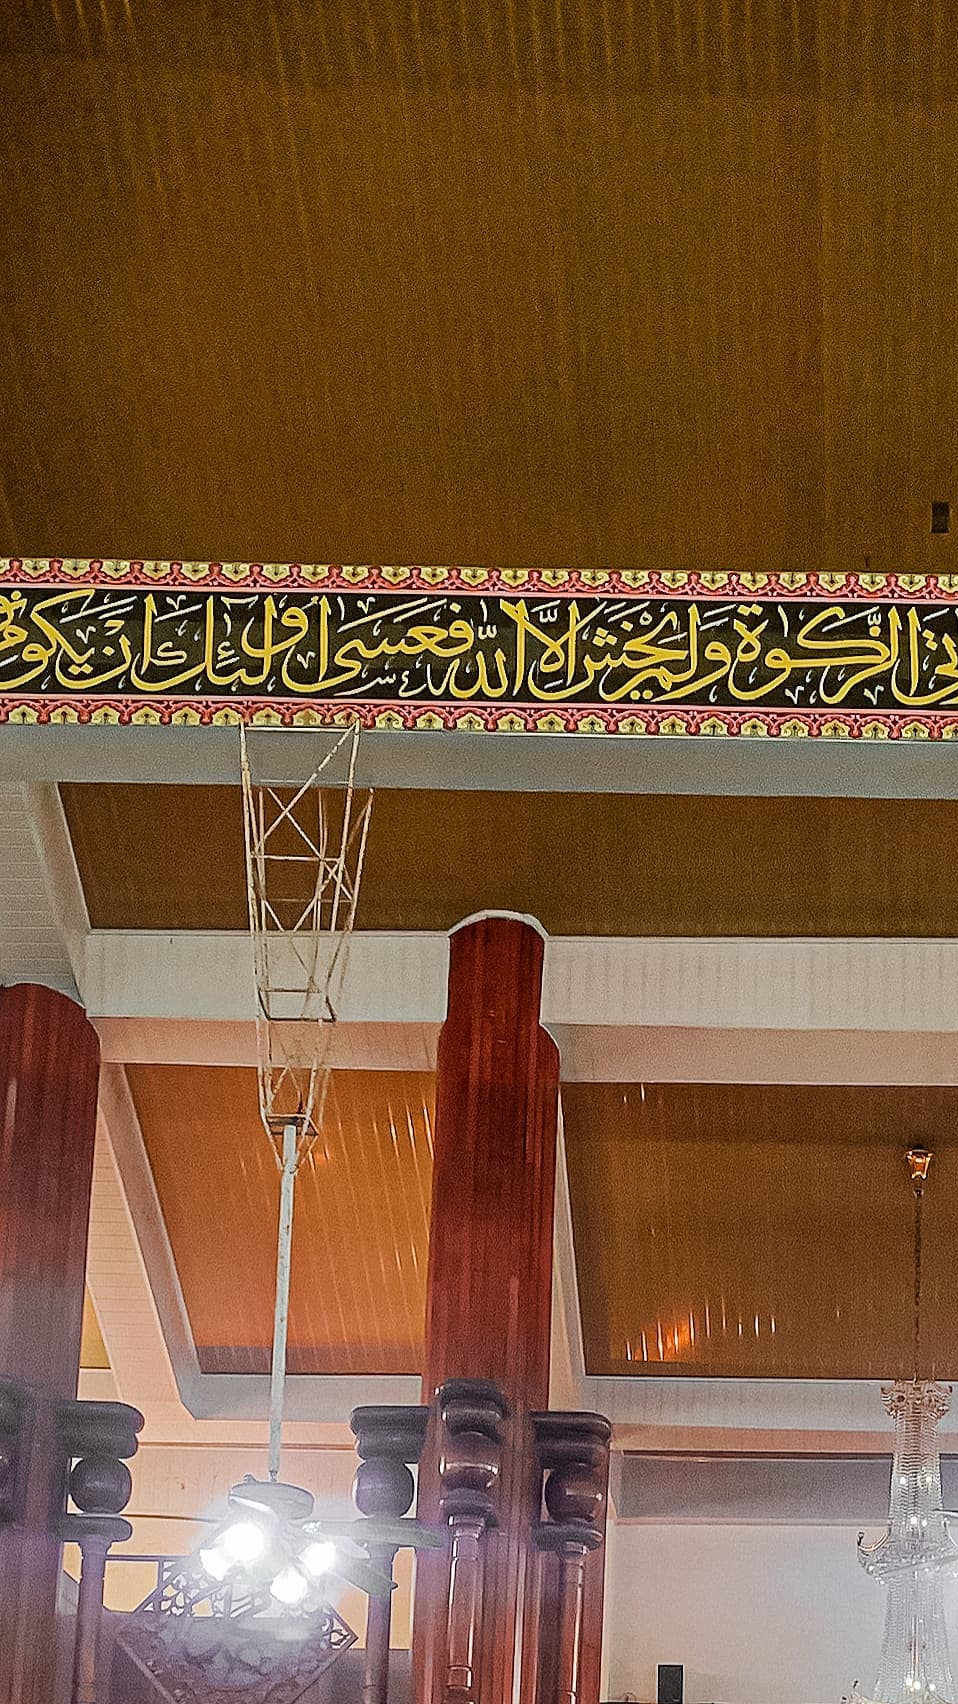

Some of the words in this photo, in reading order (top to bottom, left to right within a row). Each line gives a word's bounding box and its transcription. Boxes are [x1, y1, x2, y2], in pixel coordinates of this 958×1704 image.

[0, 588, 96, 690] يكون
[55, 594, 158, 689] ان
[448, 600, 531, 699] الله
